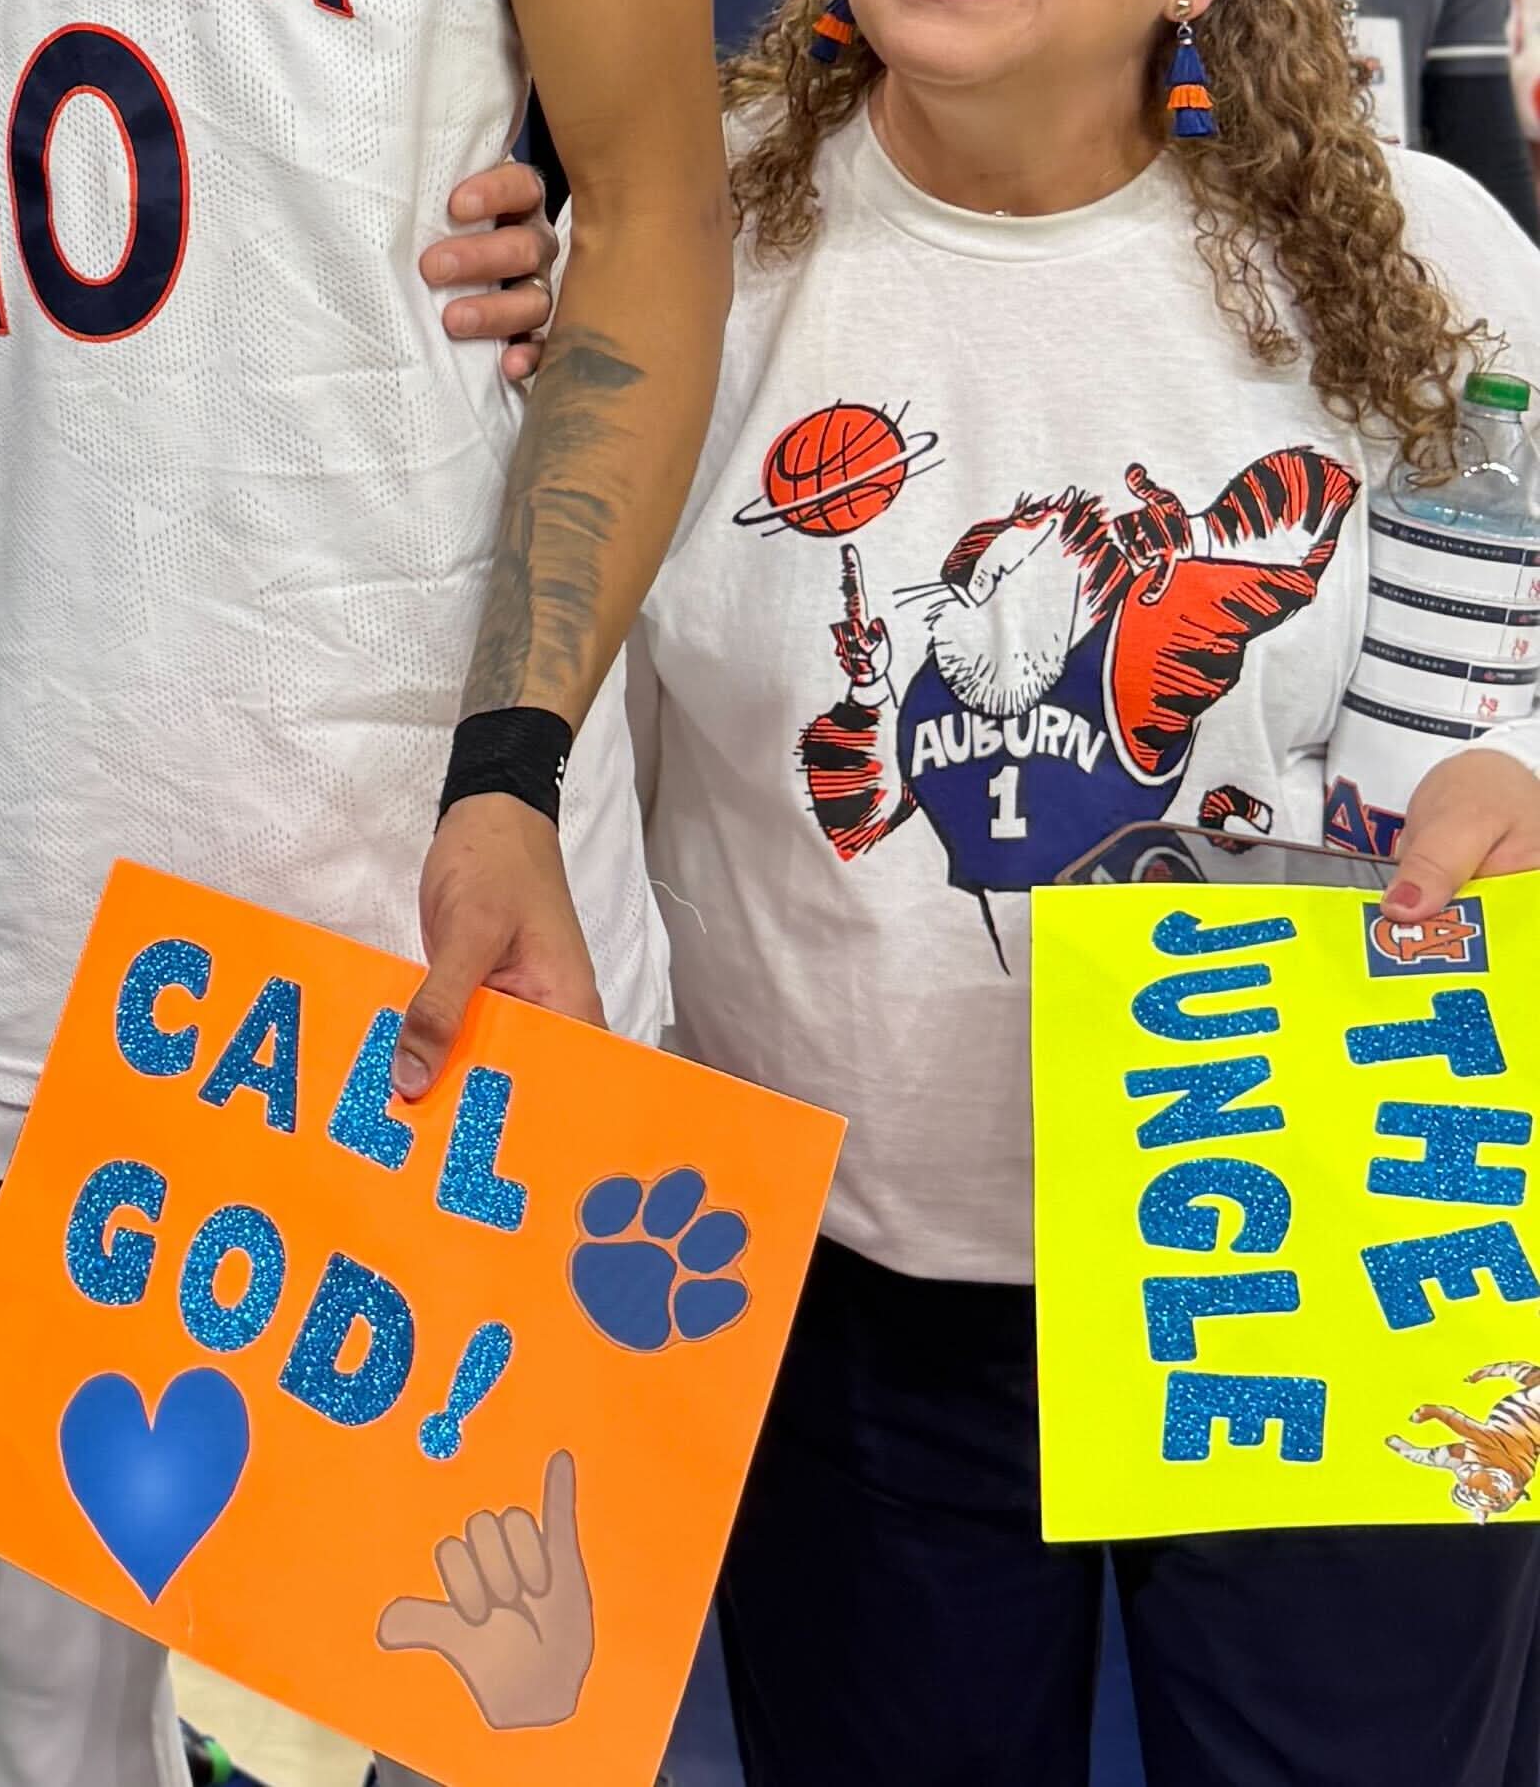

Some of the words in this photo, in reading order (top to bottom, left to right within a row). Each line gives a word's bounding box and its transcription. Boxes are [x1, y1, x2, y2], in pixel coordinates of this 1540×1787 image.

[911, 703, 1108, 775] AUBURN
[988, 765, 1028, 839] 1
[114, 938, 529, 1233] CALL
[1123, 910, 1327, 1463] JUNGLE
[1344, 987, 1540, 1330] THE
[65, 1159, 515, 1461] GOD!
